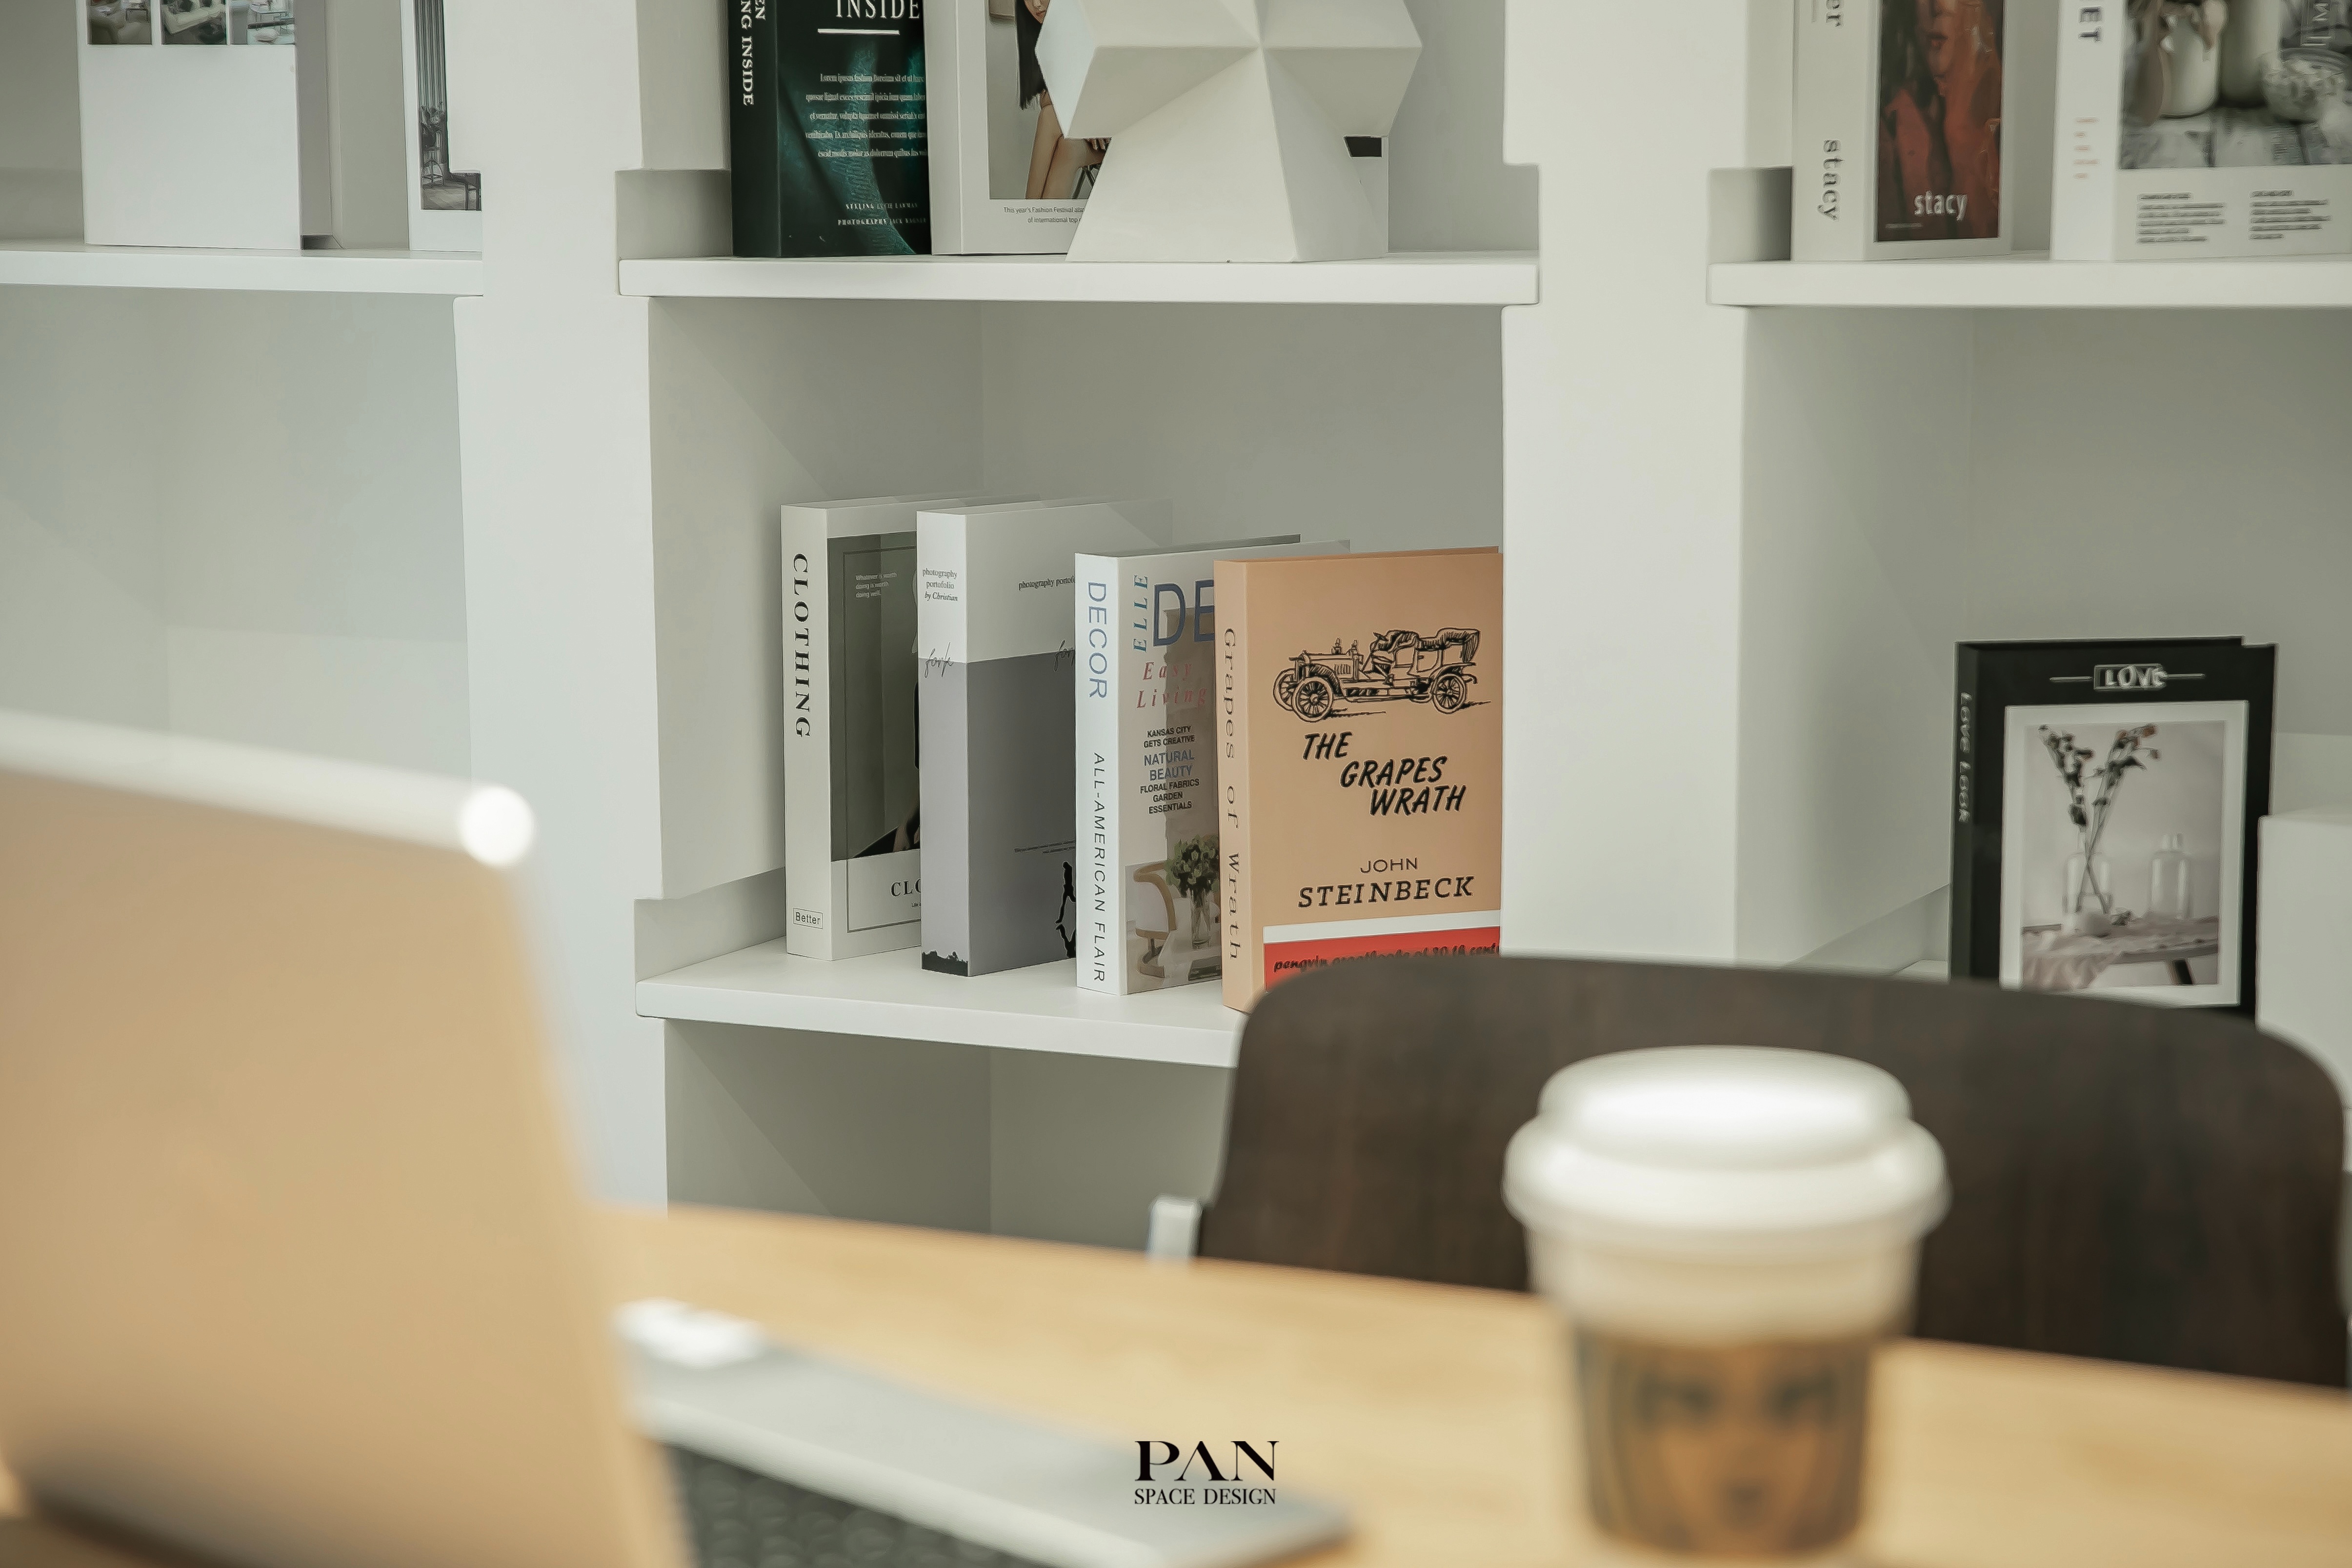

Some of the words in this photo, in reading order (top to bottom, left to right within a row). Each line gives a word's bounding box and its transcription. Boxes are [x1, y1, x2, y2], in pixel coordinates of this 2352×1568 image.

[836, 0, 919, 19] INSIDE
[742, 36, 754, 106] INSIDE
[1818, 140, 1844, 221] stacy
[1914, 191, 1968, 221] stacy
[922, 567, 957, 580] photography
[1018, 577, 1055, 591] photography
[925, 591, 931, 602] by
[932, 591, 958, 602] Christian
[1133, 575, 1148, 652] ELLE
[1153, 578, 1214, 646] DE
[793, 553, 811, 738] CLOTHING
[1088, 582, 1107, 698] DECOR
[1142, 662, 1192, 681] Easy
[2105, 665, 2169, 687] LOVE
[1136, 686, 1206, 710] Living
[1144, 739, 1161, 748] GETS
[1163, 735, 1196, 745] CREATIVE
[1147, 727, 1174, 738] KANSAS
[1176, 725, 1192, 734] CITY
[1302, 731, 1353, 760] THE
[1144, 749, 1195, 766] NATURAL
[1150, 764, 1193, 781] BEAUTY
[1340, 756, 1447, 787] GRAPES
[1140, 783, 1167, 794] FLORAL
[1169, 778, 1200, 789] FABRICS
[1153, 791, 1183, 803] GARDEN
[1148, 801, 1192, 814] ESSENTIALS
[1370, 784, 1466, 815] WRATH
[1094, 752, 1106, 912] ALL-AMERICAN
[1360, 857, 1419, 873] JOHN
[1298, 876, 1474, 907] STEINBECK
[1228, 852, 1241, 960] Wrath
[796, 911, 821, 925] Better
[1094, 921, 1106, 982] FLAIR
